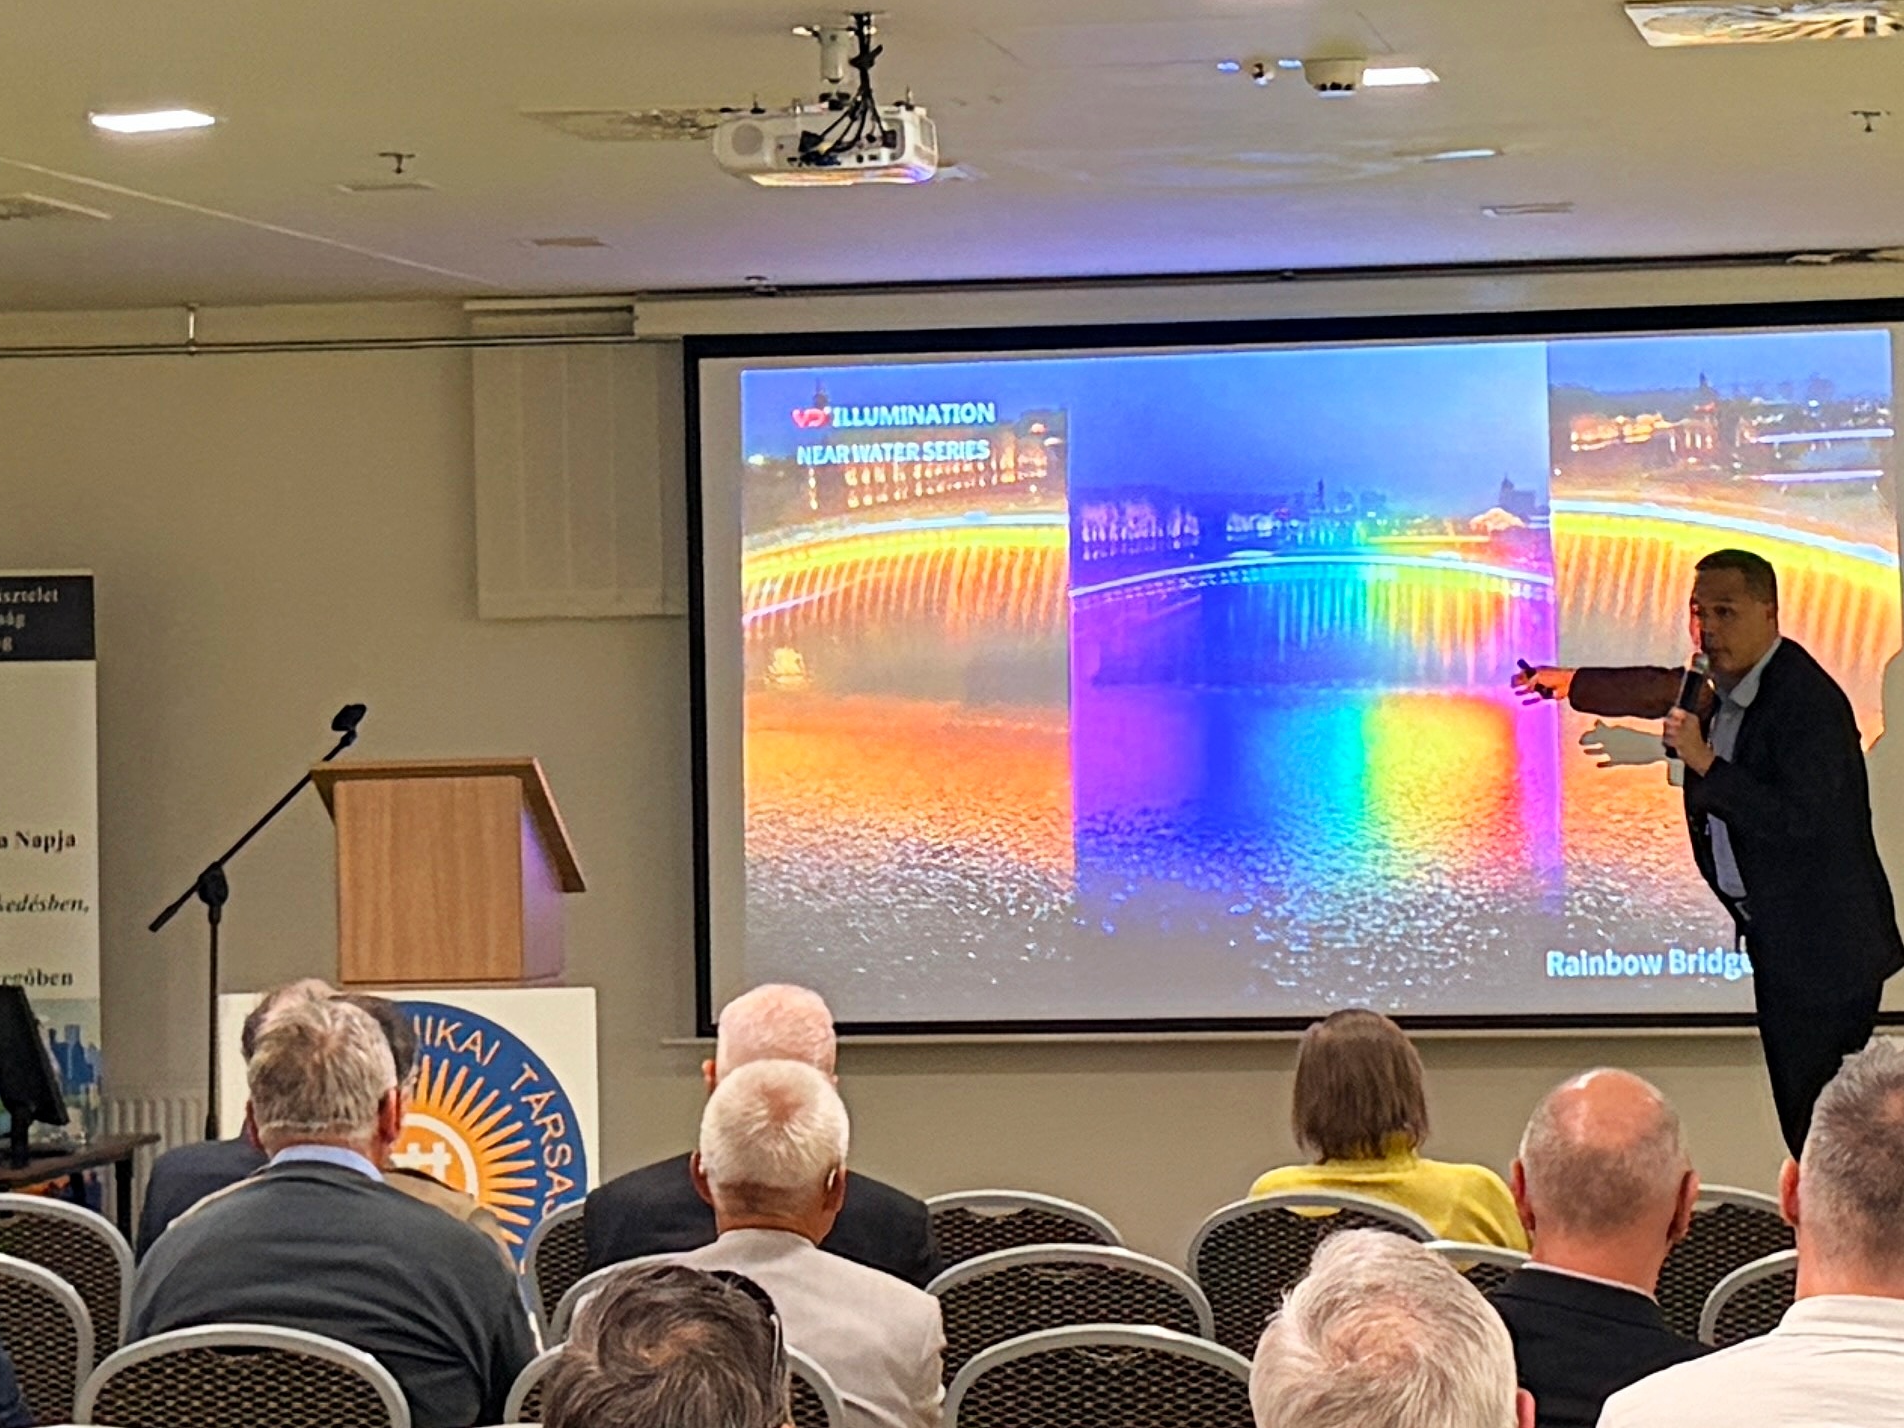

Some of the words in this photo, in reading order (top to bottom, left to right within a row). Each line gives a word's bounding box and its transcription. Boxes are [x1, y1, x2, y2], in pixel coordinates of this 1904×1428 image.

[831, 402, 996, 428] ILLUMINATION
[797, 444, 850, 465] NEAR
[852, 441, 920, 463] WATER
[922, 439, 991, 461] SERIES
[15, 829, 77, 854] Napja
[1546, 948, 1663, 977] Rainbow
